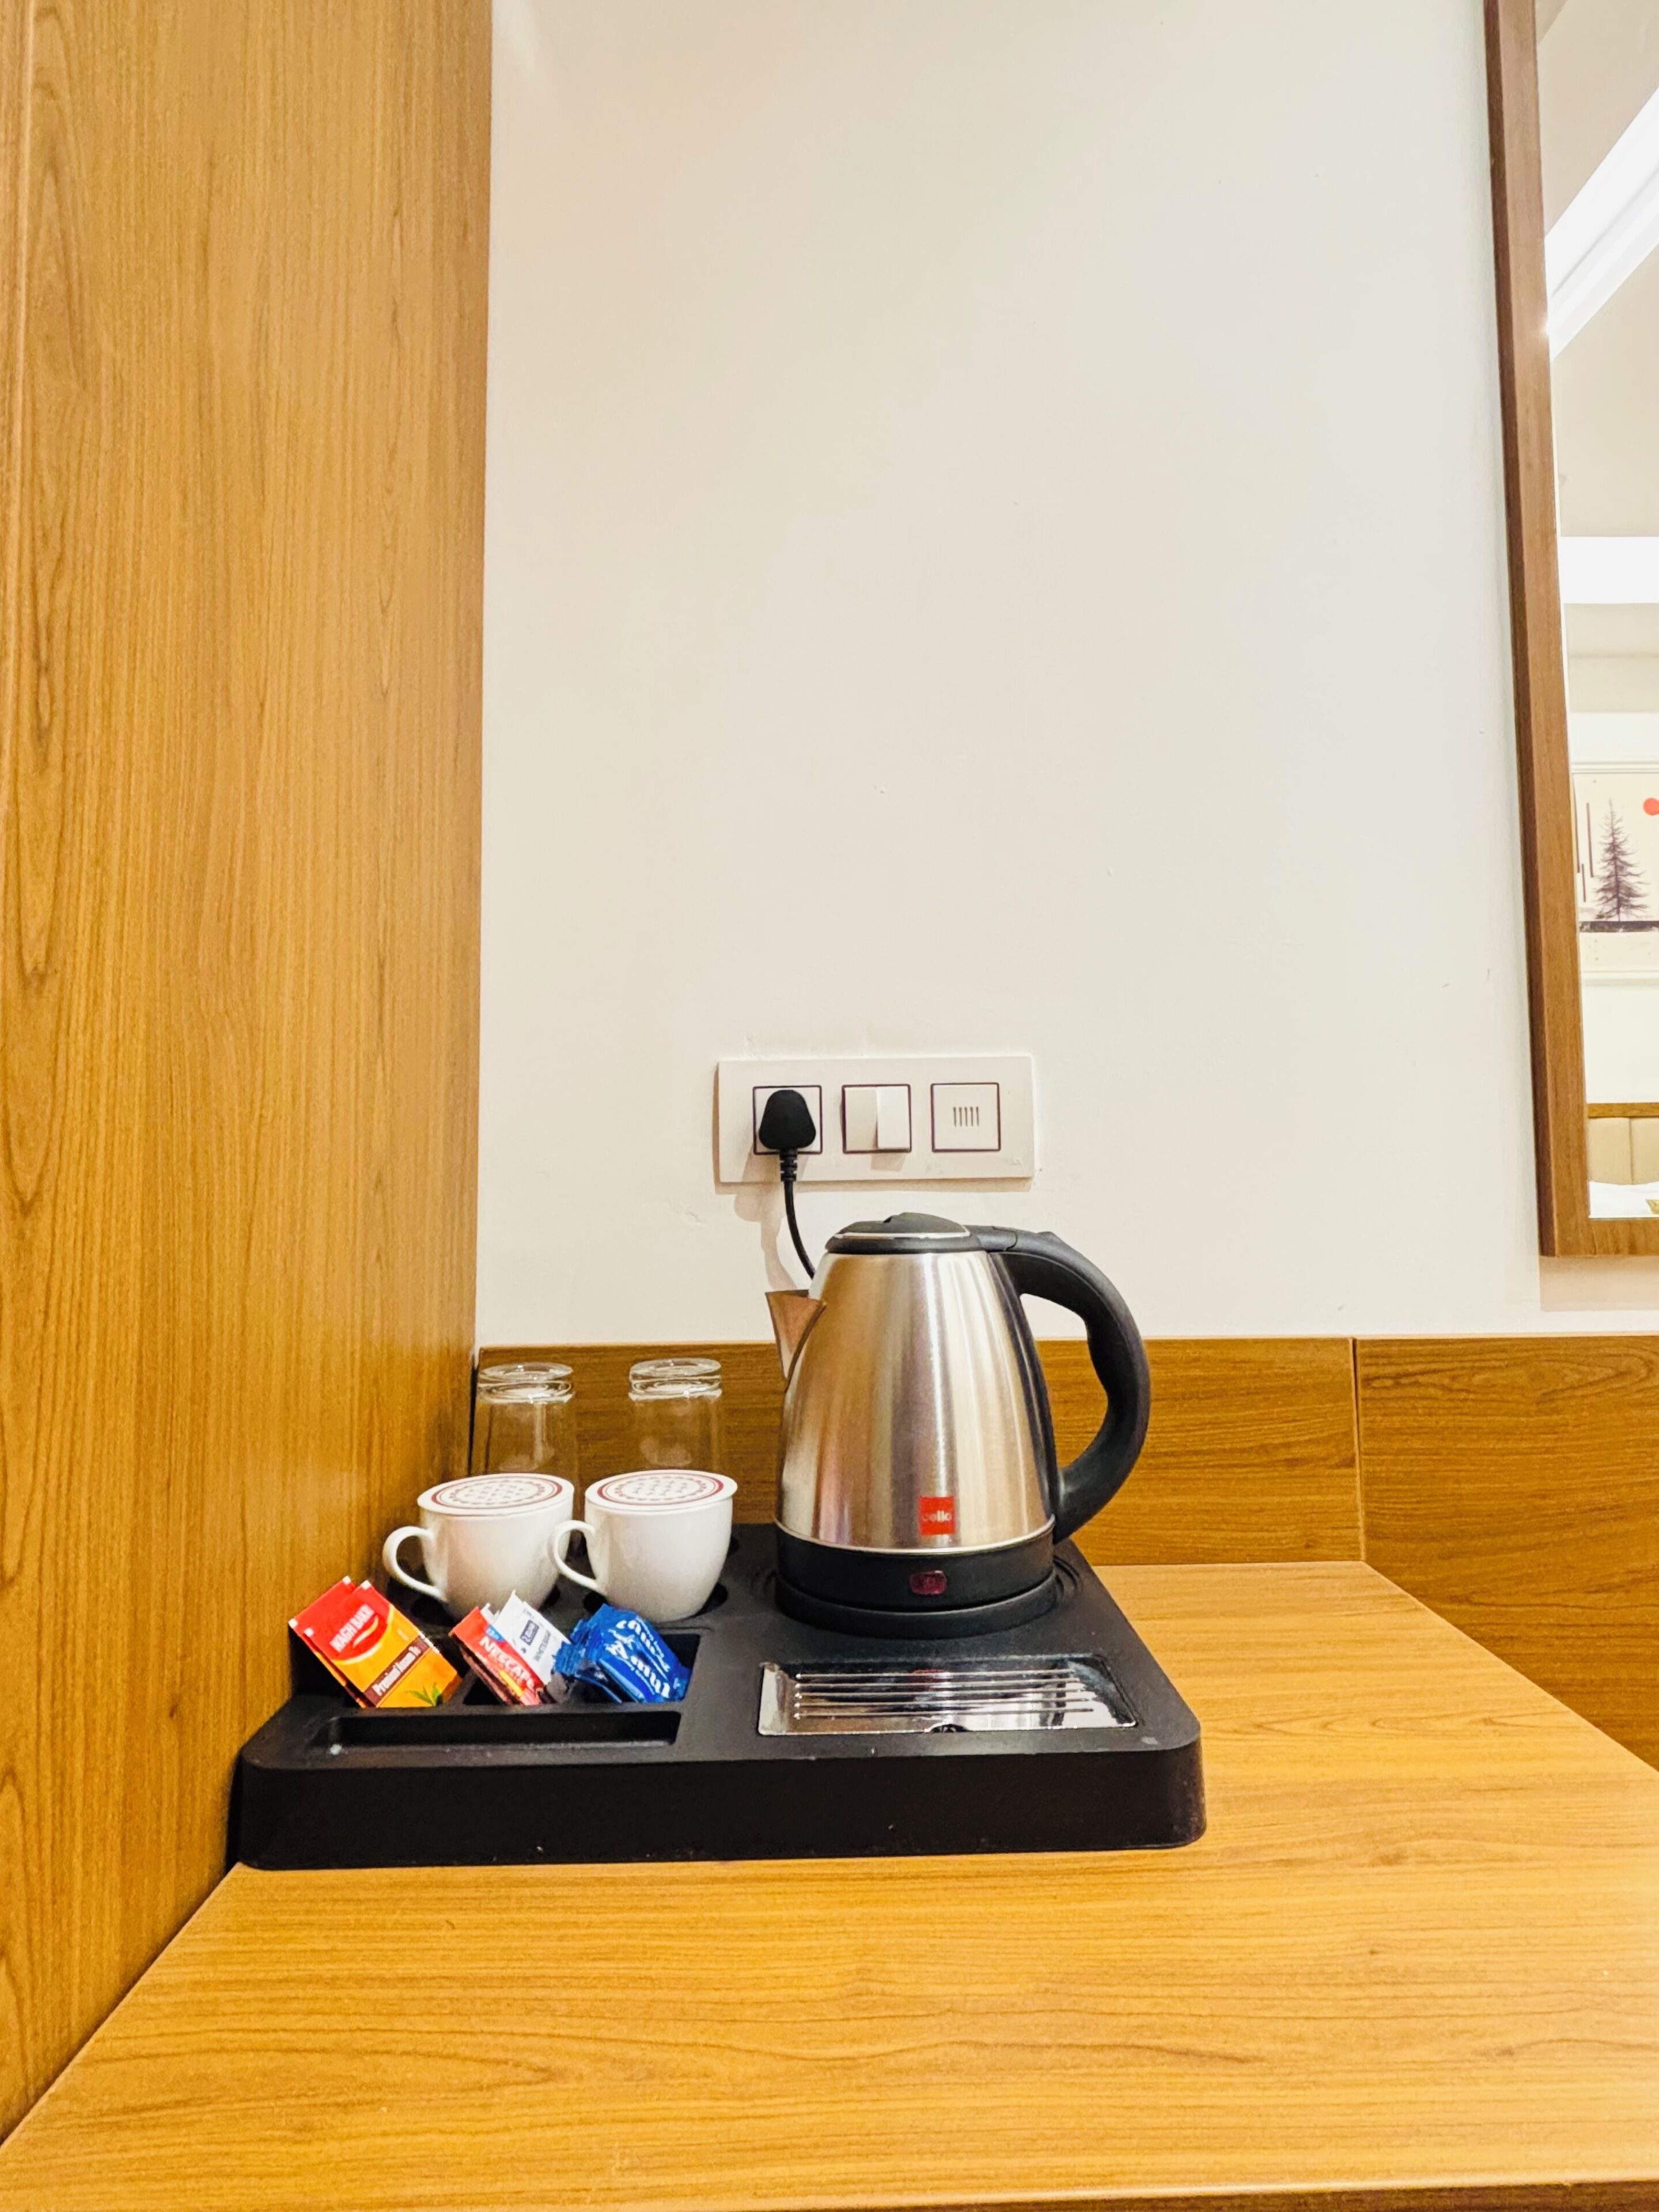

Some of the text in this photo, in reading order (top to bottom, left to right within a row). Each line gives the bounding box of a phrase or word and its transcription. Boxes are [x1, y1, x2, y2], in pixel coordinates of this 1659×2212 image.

[922, 1510, 952, 1522] cello
[329, 1621, 357, 1653] WAGH
[605, 1641, 671, 1698] Amul
